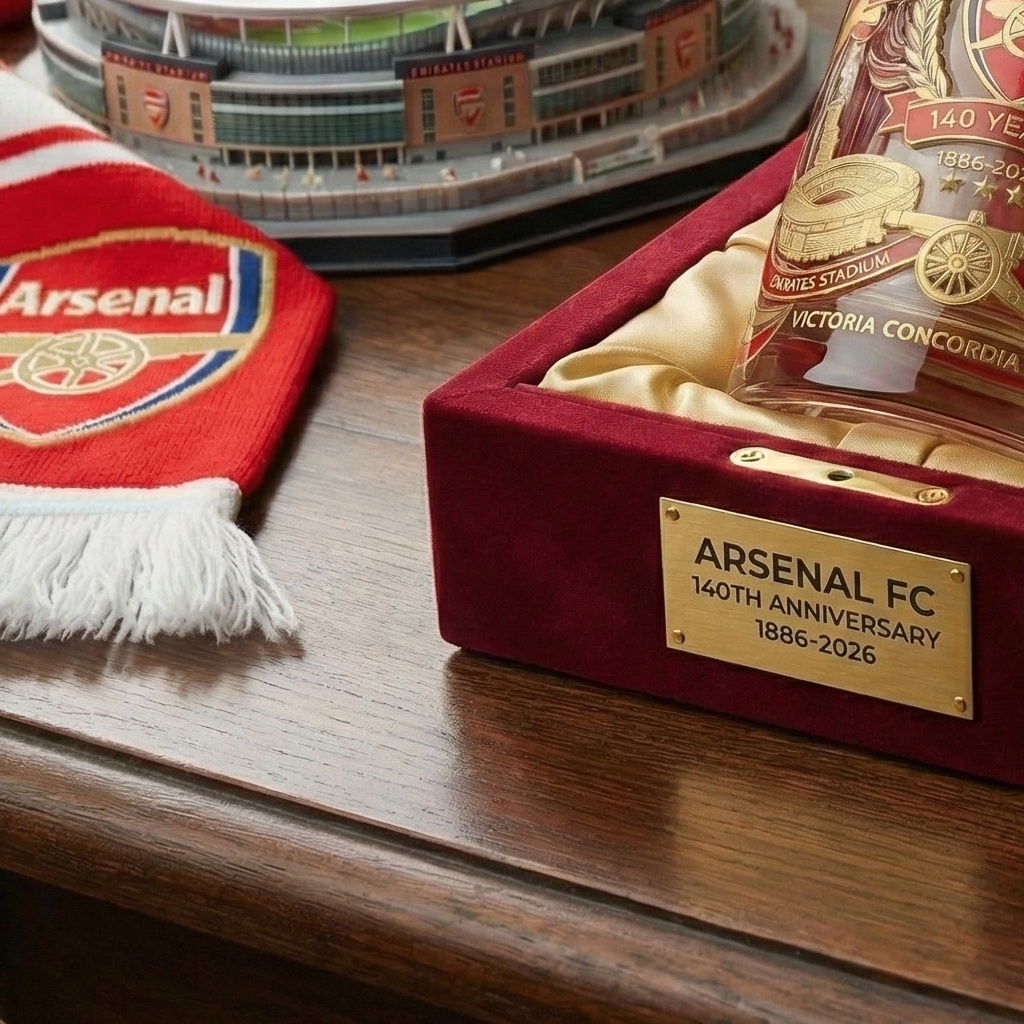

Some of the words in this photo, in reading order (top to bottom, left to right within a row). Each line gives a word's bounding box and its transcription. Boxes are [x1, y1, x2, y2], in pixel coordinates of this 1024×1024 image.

[930, 108, 976, 130] 140
[819, 250, 891, 287] STADIUM
[1, 273, 226, 317] Arsenal
[792, 309, 876, 335] VICTORIA
[882, 319, 1021, 374] CONCORDIA
[694, 536, 875, 605] ARSENAL
[886, 578, 936, 617] FC
[691, 574, 763, 609] 140TH
[768, 593, 942, 650] ANNIVERSARY
[755, 618, 877, 665] 1886-2026
